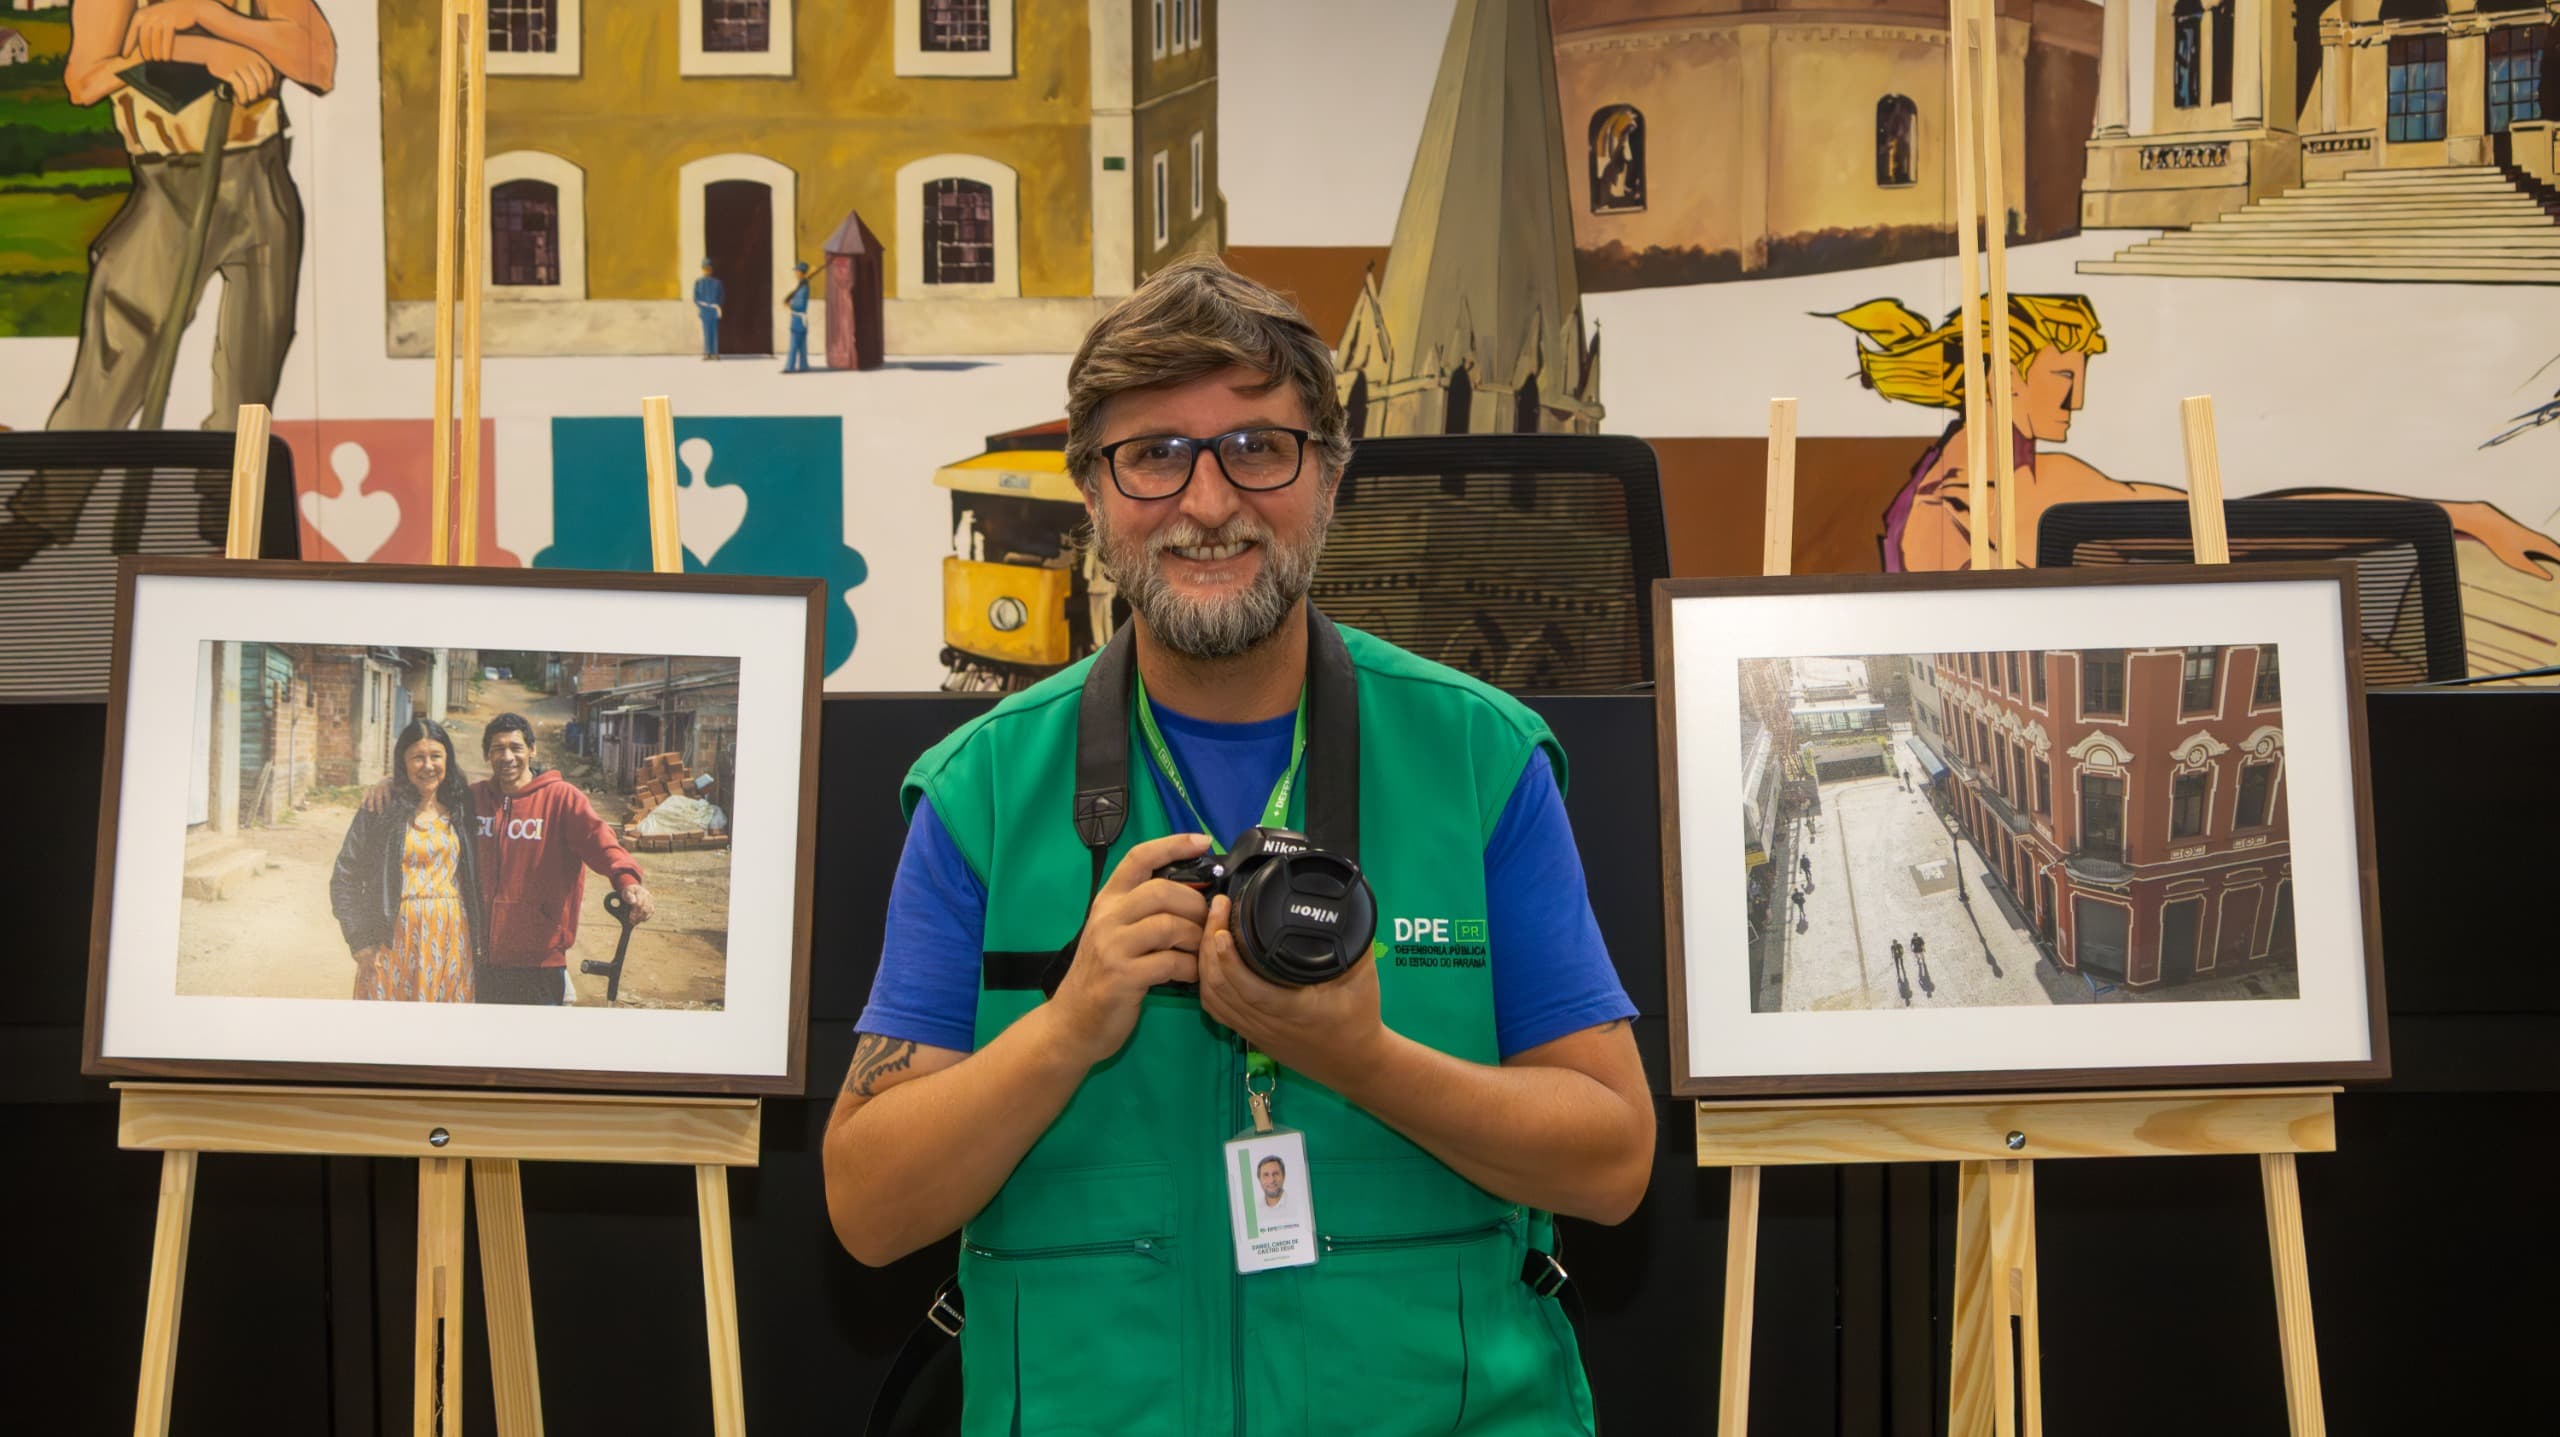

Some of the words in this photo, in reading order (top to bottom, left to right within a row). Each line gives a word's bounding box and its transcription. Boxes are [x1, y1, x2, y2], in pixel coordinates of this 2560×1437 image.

[1290, 904, 1339, 924] Nikon
[1393, 917, 1449, 942] DPE
[1394, 944, 1446, 955] DEFENSORIA
[1395, 957, 1408, 967] DO
[1409, 957, 1439, 968] ESTADO
[1440, 957, 1451, 968] DO
